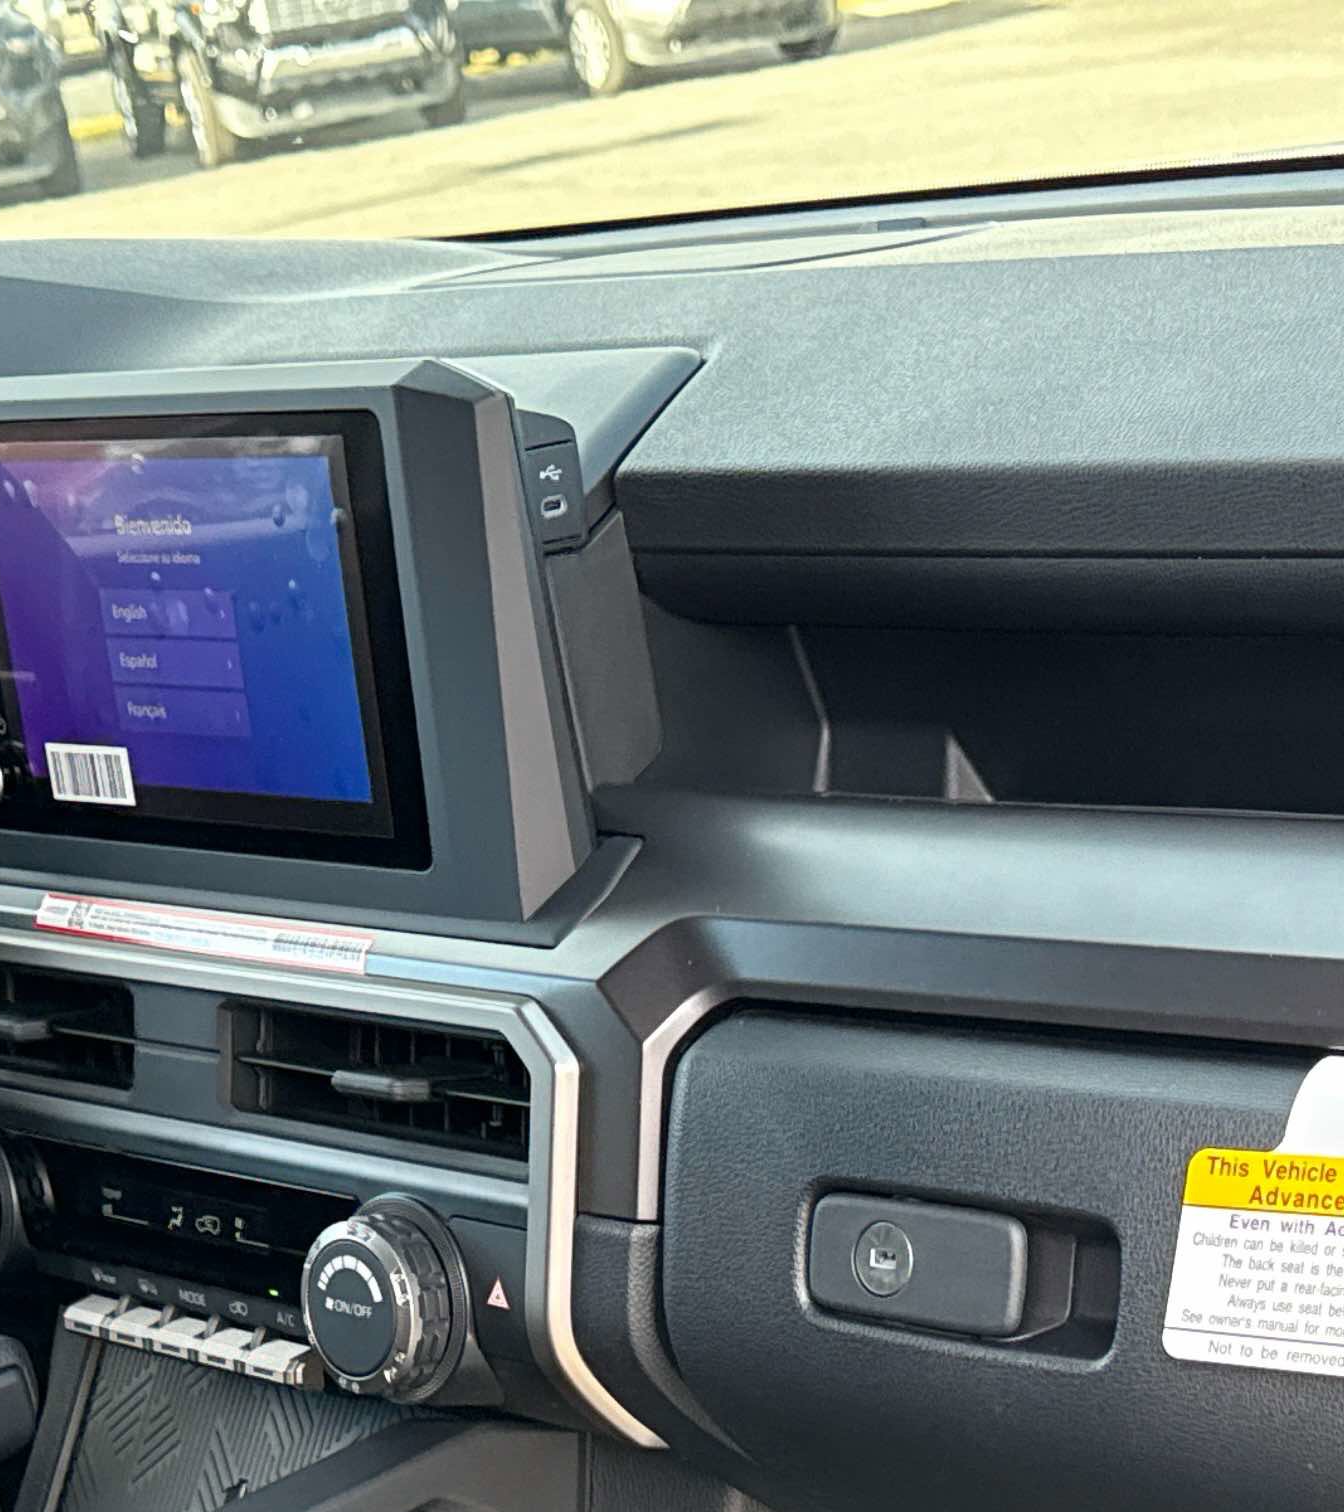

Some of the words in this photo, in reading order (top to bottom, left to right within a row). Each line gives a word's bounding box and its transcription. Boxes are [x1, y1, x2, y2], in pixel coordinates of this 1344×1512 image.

[111, 603, 147, 623] English
[119, 651, 157, 670] Español
[127, 701, 167, 720] Français
[1206, 1155, 1248, 1177] This
[1263, 1159, 1336, 1183] Vehicle
[1229, 1213, 1269, 1231] Even
[1280, 1219, 1314, 1234] with
[1193, 1231, 1237, 1247] Children
[1243, 1239, 1263, 1250] can
[1269, 1239, 1283, 1253] be
[1290, 1239, 1318, 1255] killed
[1324, 1245, 1335, 1256] or
[1221, 1253, 1242, 1268] The
[1248, 1255, 1273, 1270] back
[1281, 1261, 1304, 1273] seat
[1310, 1262, 1319, 1275] is
[1326, 1263, 1342, 1276] the
[1218, 1273, 1250, 1288] Never
[1255, 1279, 1275, 1293] put
[1280, 1281, 1287, 1292] a
[334, 1299, 372, 1319] ON/OFF
[1227, 1293, 1265, 1312] Always
[1272, 1301, 1291, 1312] use
[1299, 1303, 1322, 1315] seat
[276, 1311, 296, 1327] A/C
[1181, 1308, 1202, 1323] See
[1209, 1314, 1250, 1328] owner's
[1258, 1319, 1298, 1332] manual
[1304, 1319, 1318, 1335] for
[1208, 1339, 1231, 1354] Not
[1239, 1343, 1252, 1357] to
[1260, 1345, 1277, 1360] be
